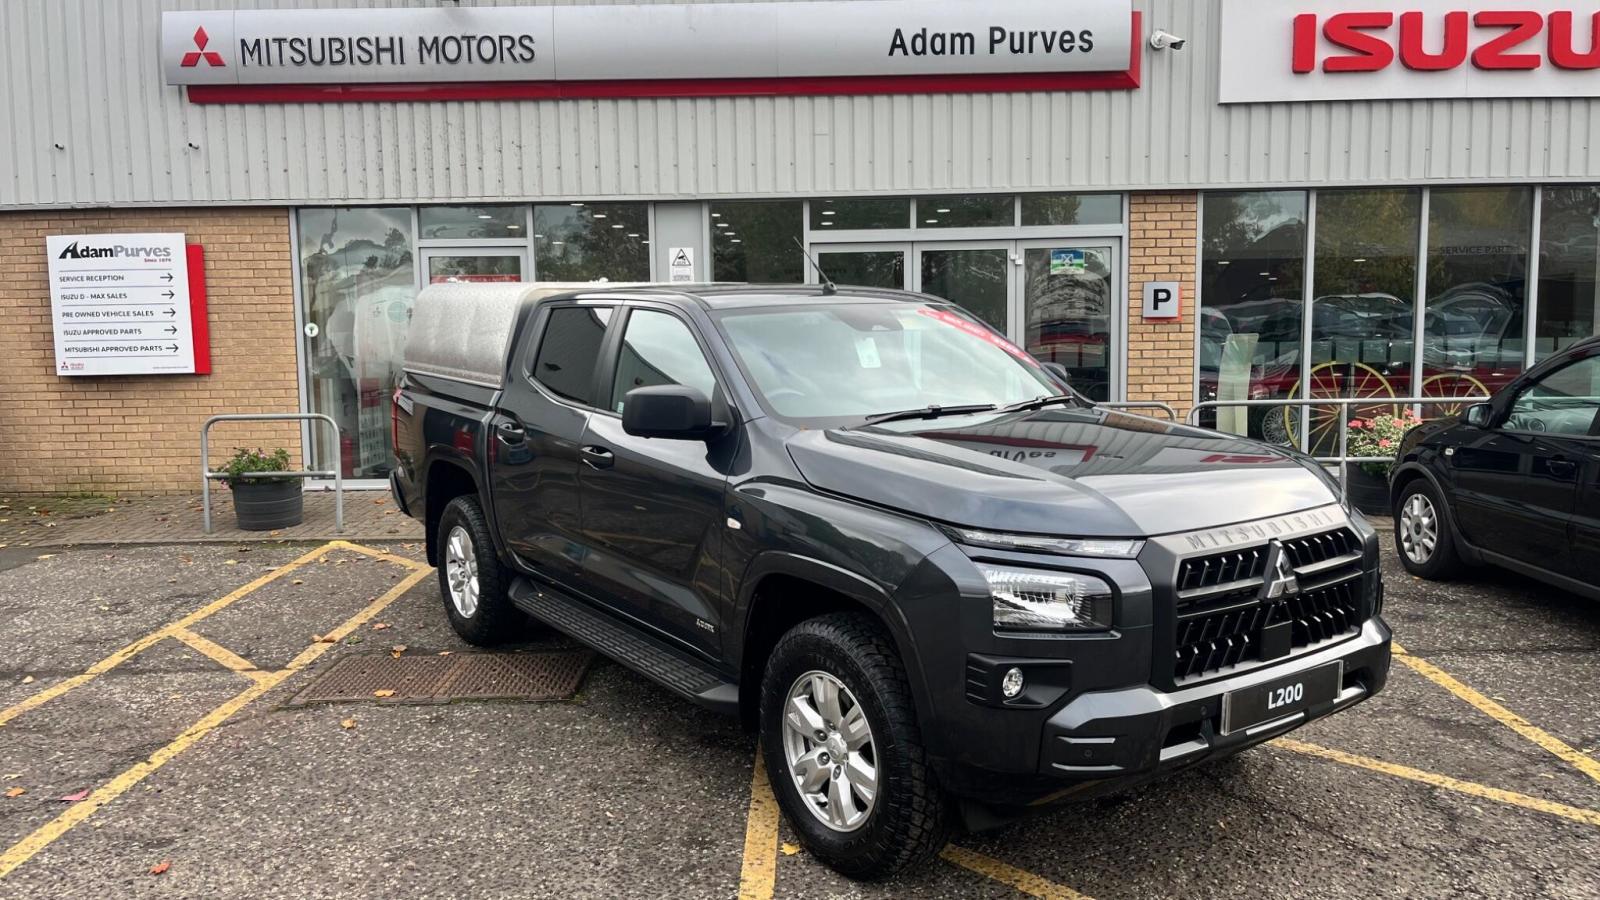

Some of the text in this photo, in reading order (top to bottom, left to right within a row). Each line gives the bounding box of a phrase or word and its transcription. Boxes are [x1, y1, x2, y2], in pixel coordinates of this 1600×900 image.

[240, 35, 536, 66] MITSUBISHI MOTORS
[888, 26, 1094, 57] Adam Purves
[1292, 11, 1600, 74] ISUZU
[59, 241, 171, 259] AdamPurves
[1440, 246, 1482, 255] SERVICE
[1153, 289, 1171, 310] P
[1184, 511, 1333, 550] MITSUBISHI
[1268, 683, 1303, 709] L200
